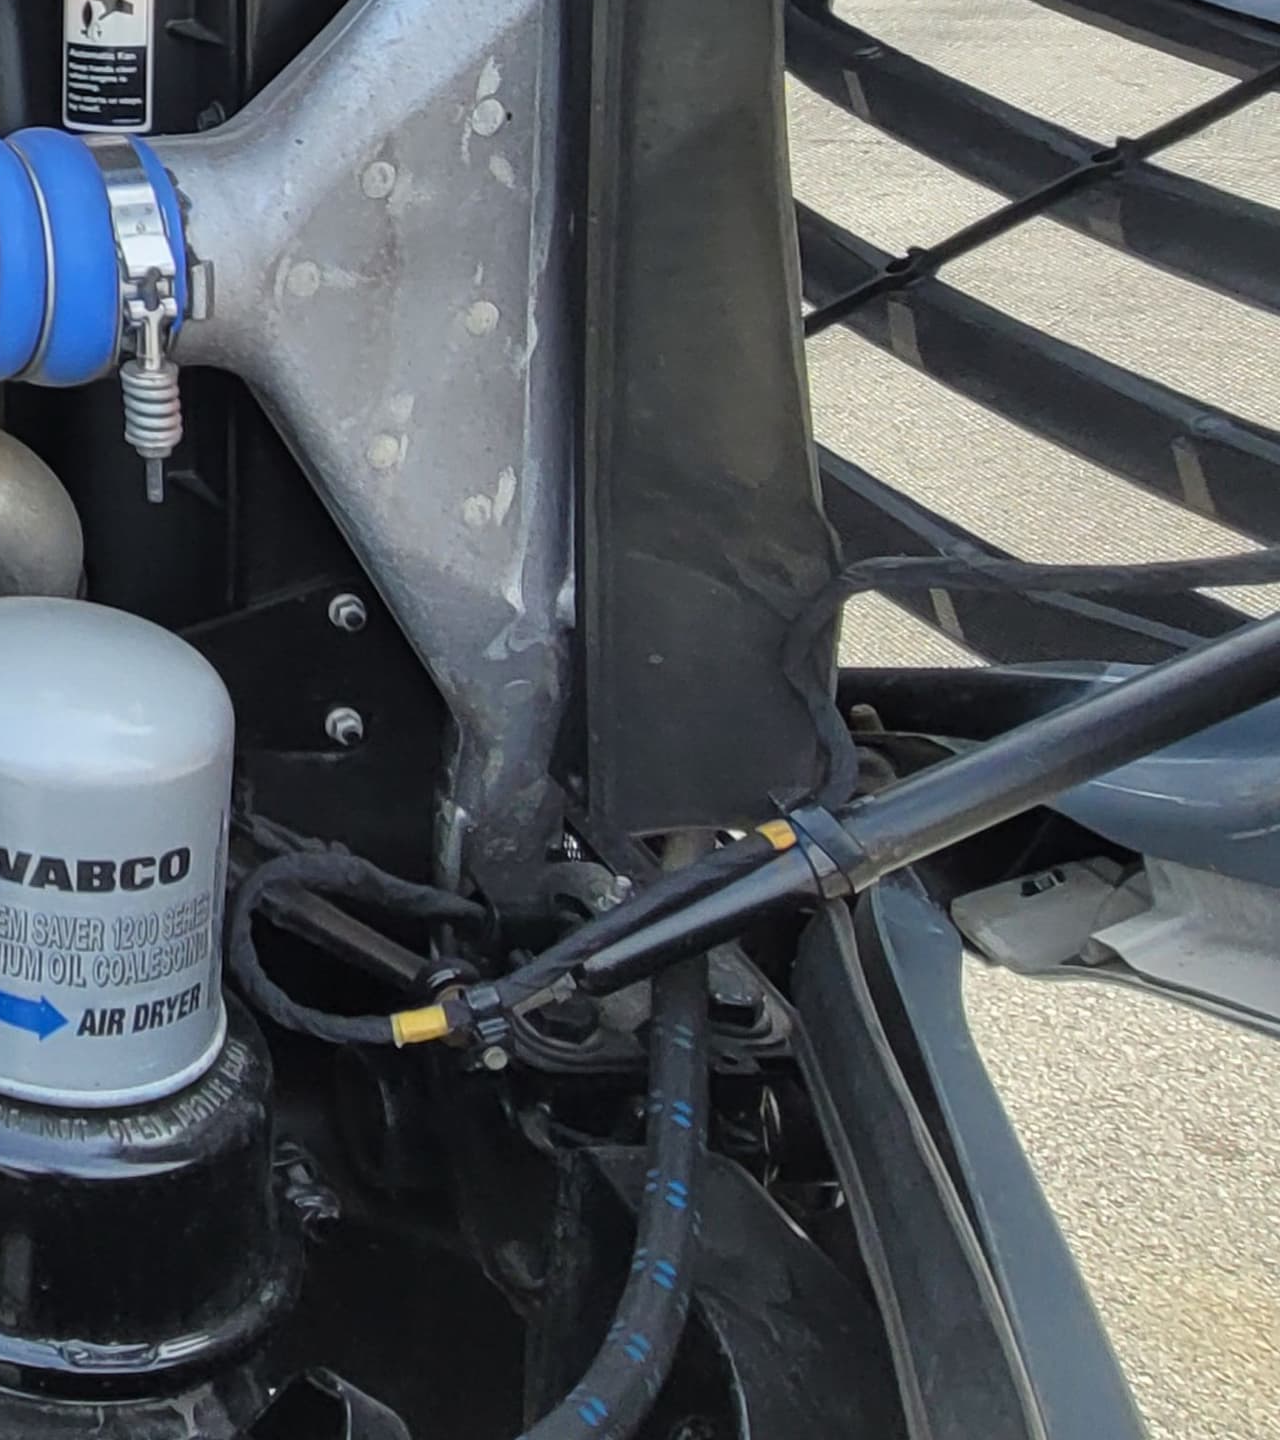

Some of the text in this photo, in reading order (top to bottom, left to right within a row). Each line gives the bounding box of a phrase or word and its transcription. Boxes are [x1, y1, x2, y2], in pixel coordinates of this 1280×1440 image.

[32, 914, 104, 952] SAVER
[111, 911, 160, 951] 1200
[48, 952, 88, 988] OIL
[77, 982, 202, 1037] AIR DRYER
